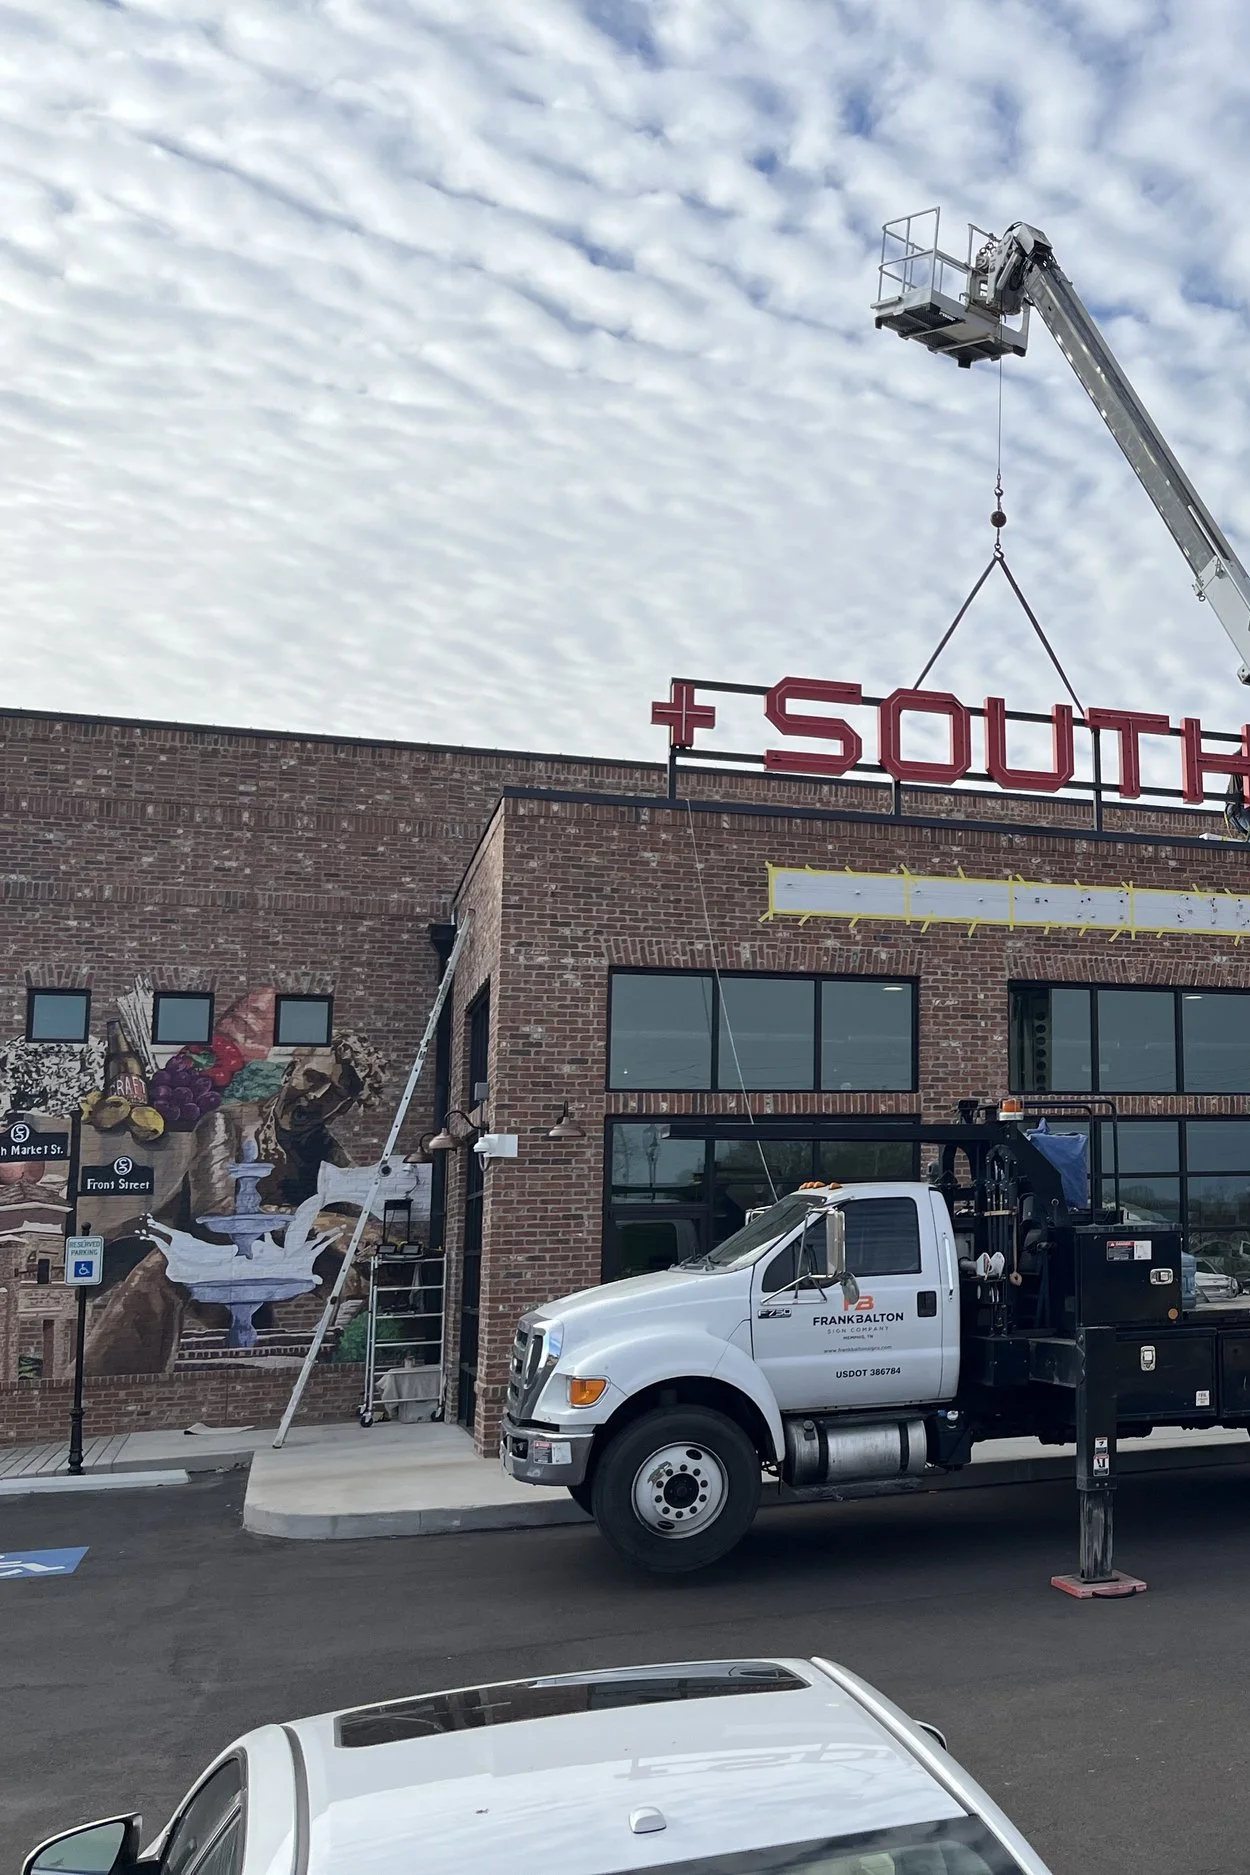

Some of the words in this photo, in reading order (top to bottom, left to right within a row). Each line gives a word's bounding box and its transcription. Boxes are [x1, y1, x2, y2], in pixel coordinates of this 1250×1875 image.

[10, 1145, 48, 1156] Market
[50, 1144, 64, 1155] St.
[87, 1178, 115, 1190] Front
[118, 1178, 150, 1190] Street
[850, 1326, 889, 1334] COMPANY
[835, 1369, 868, 1379] USDOT
[870, 1367, 901, 1377] 386784
